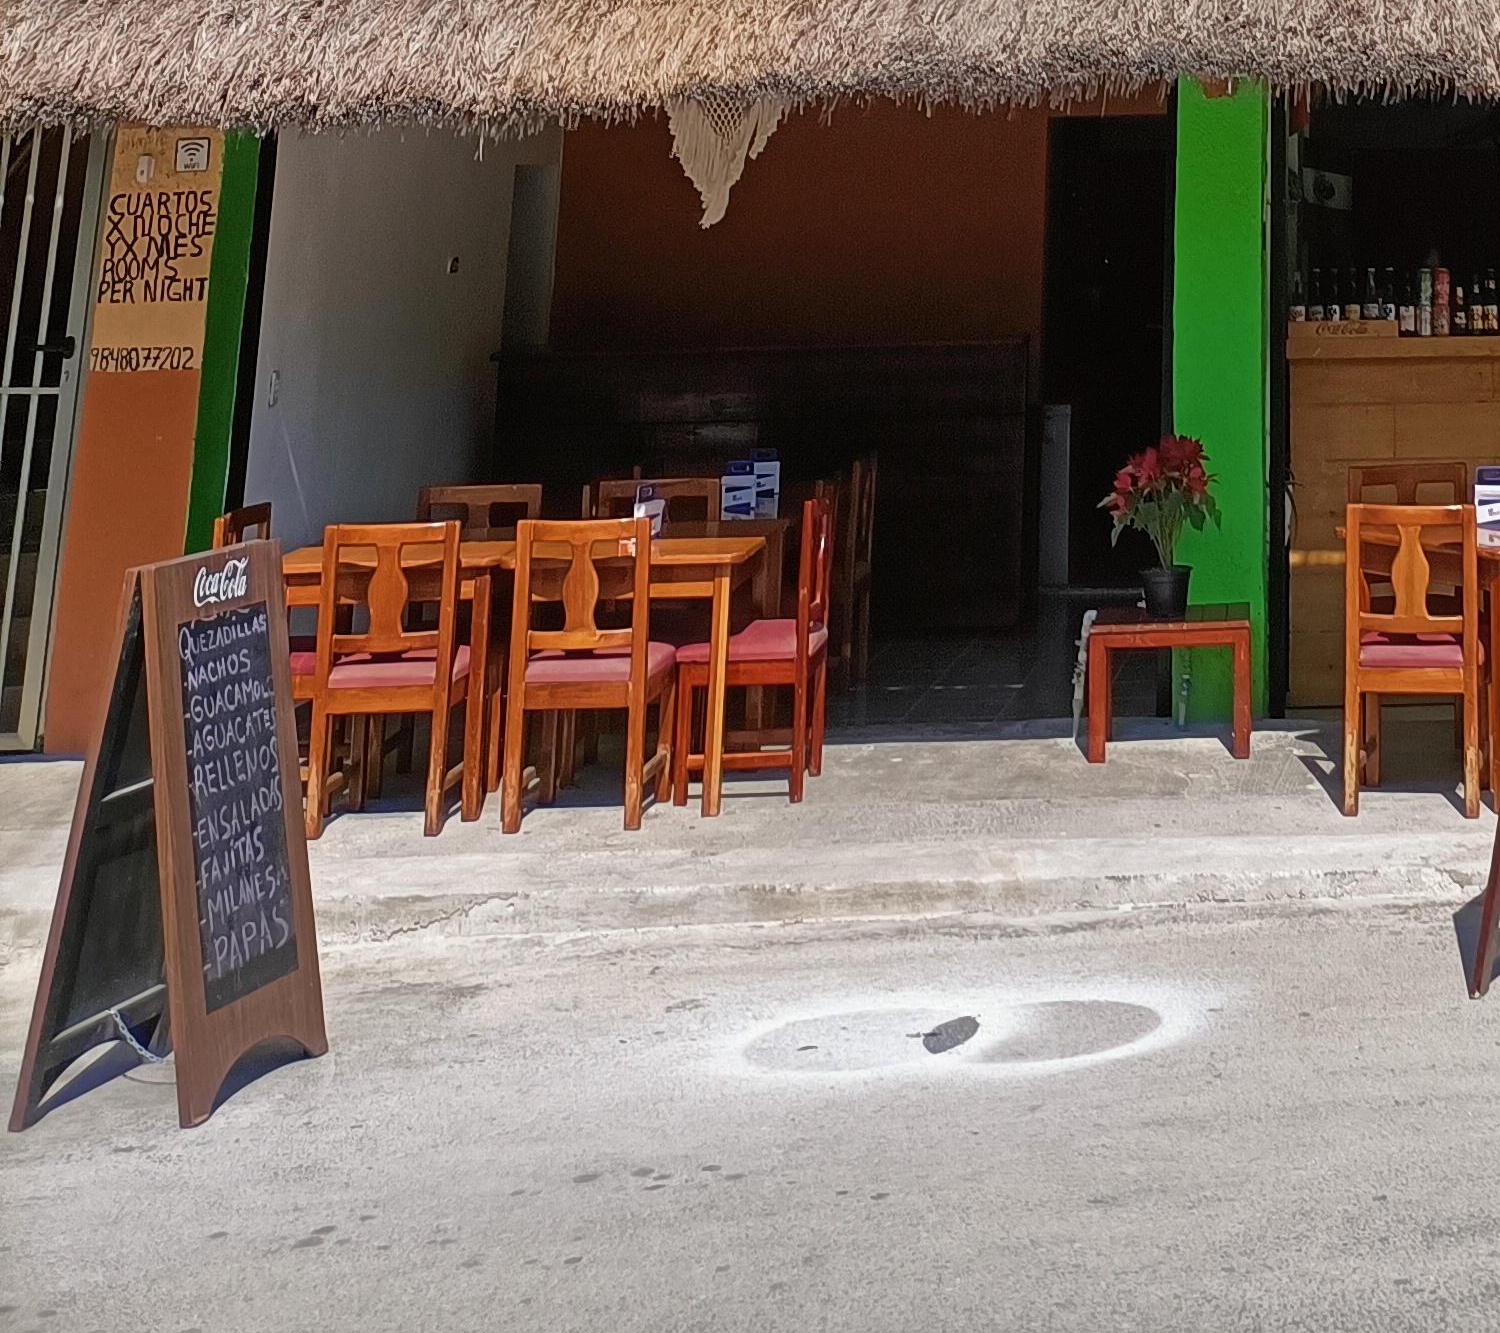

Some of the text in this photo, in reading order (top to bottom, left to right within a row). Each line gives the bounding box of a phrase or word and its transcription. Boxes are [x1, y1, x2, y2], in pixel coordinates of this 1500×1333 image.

[109, 190, 213, 217] CUARTOS
[146, 234, 203, 259] MES
[102, 257, 178, 282] ROOMS
[97, 277, 209, 304] PER NIGHT
[90, 346, 194, 371] 9848077202
[193, 555, 249, 608] Coca-Cola
